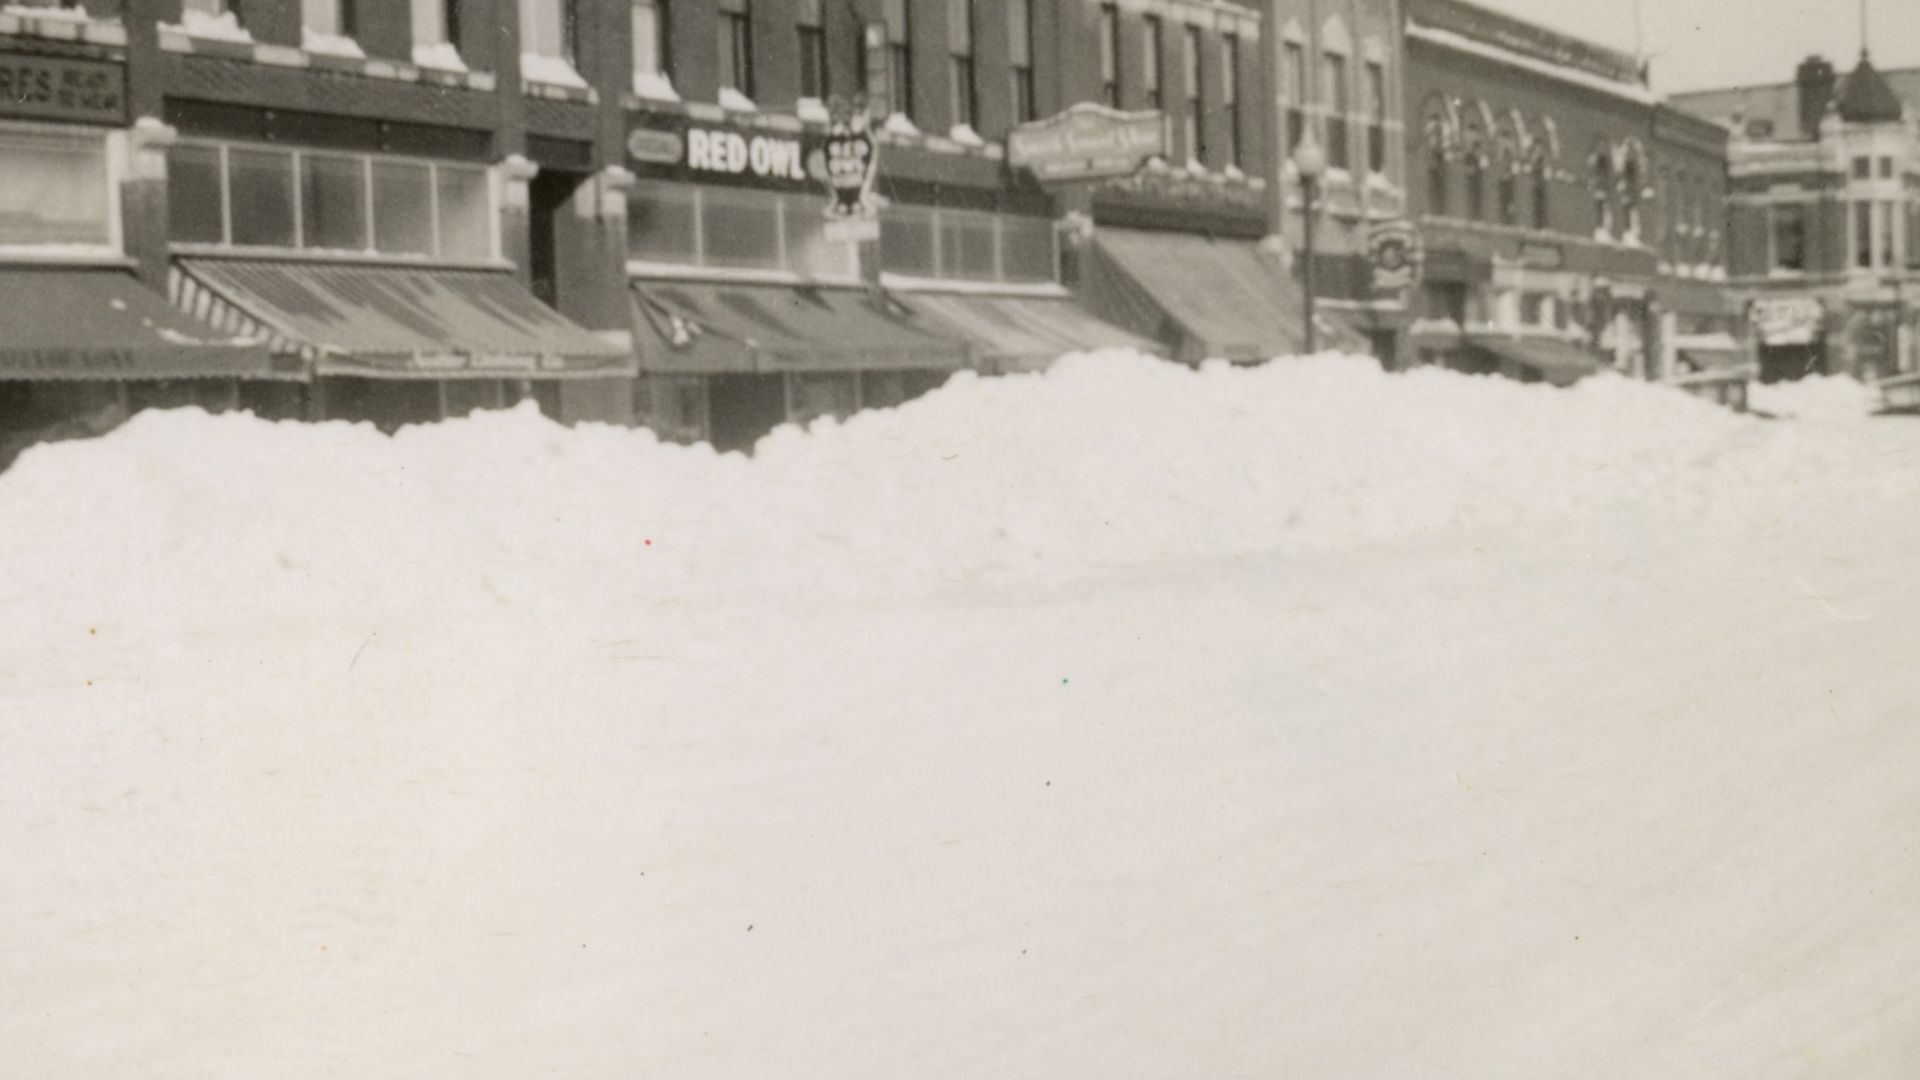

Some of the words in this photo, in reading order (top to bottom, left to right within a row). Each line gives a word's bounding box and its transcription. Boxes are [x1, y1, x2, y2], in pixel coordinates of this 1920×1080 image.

[687, 127, 748, 174] RED
[751, 135, 805, 180] OWL
[828, 139, 869, 158] RED
